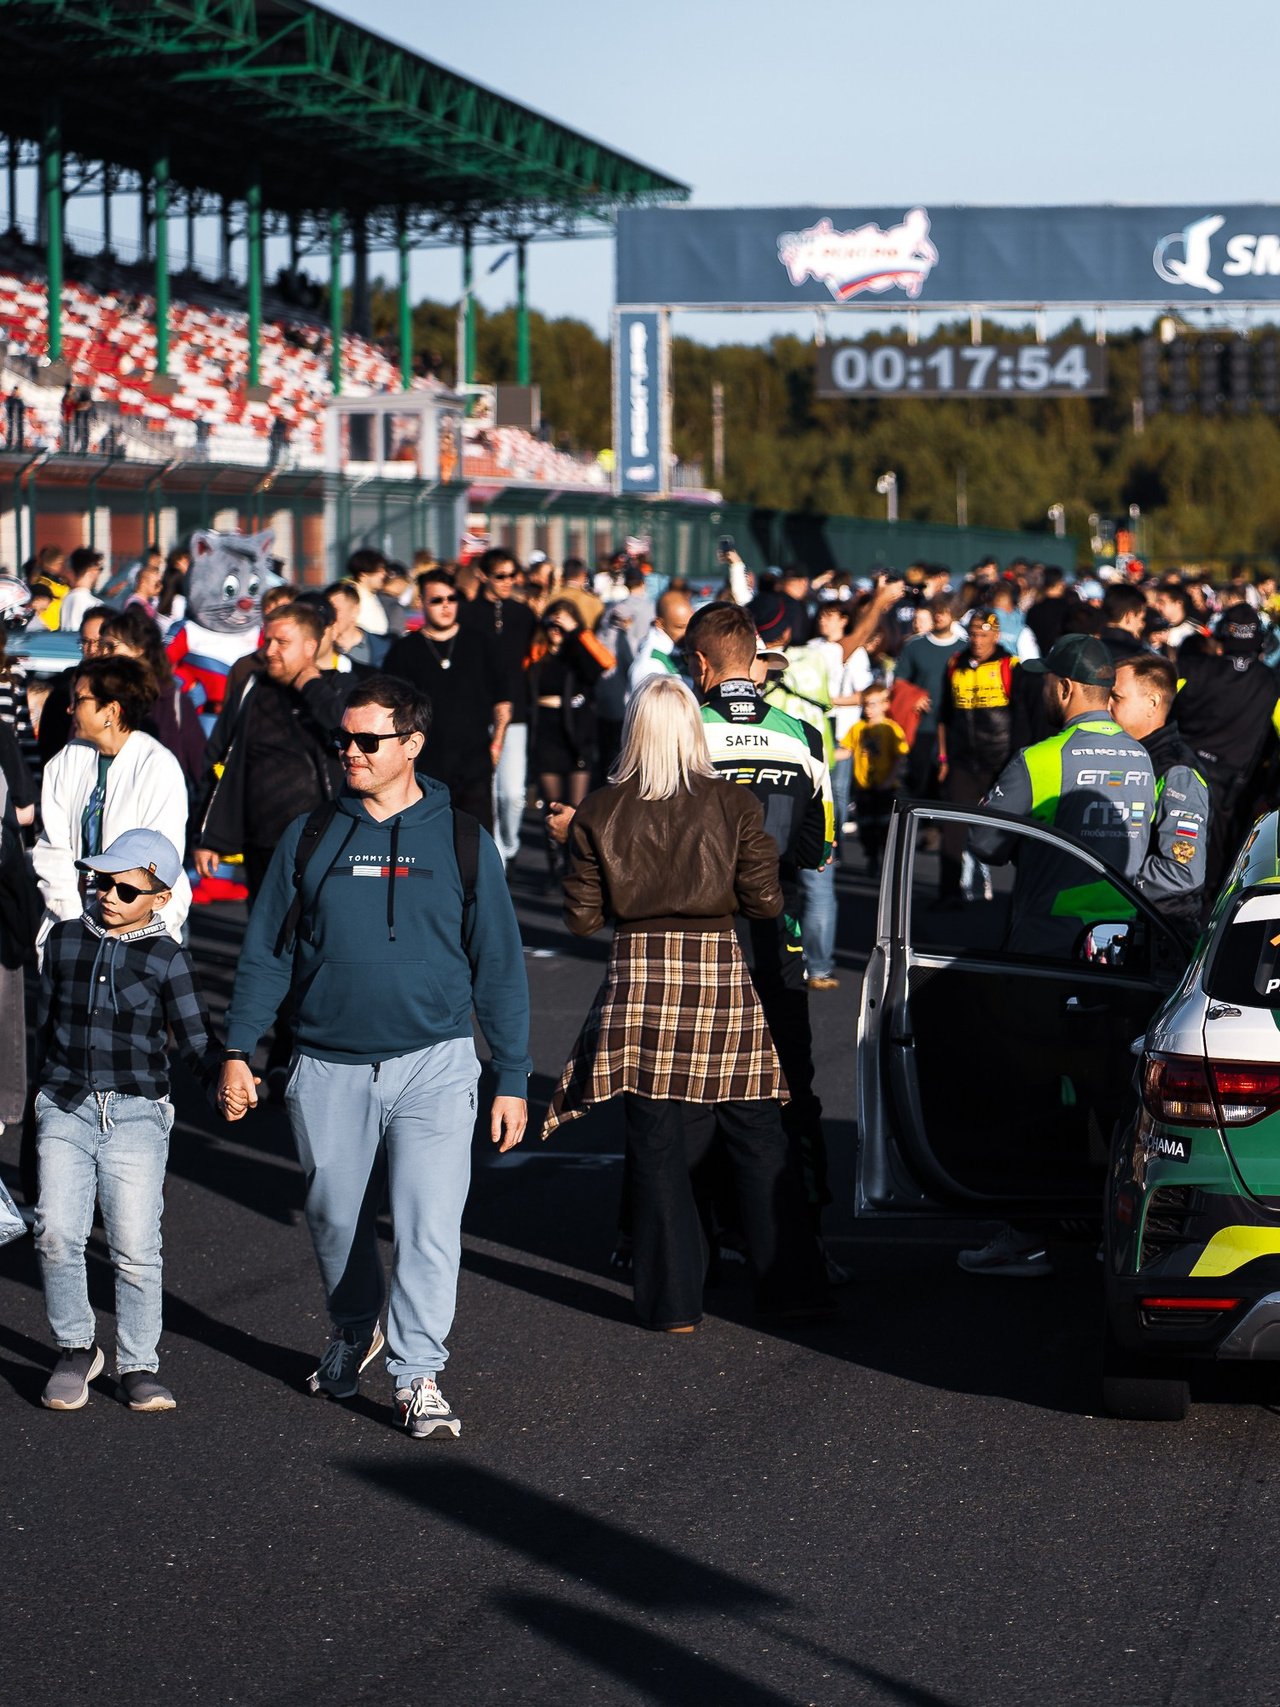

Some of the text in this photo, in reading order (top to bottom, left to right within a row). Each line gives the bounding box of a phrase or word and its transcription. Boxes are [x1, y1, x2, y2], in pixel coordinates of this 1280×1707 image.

[832, 345, 1092, 392] 00:17:54
[730, 704, 756, 713] OMP
[726, 735, 769, 746] SAFIN
[711, 768, 798, 786] TERT
[348, 854, 416, 864] TOMMY SORT
